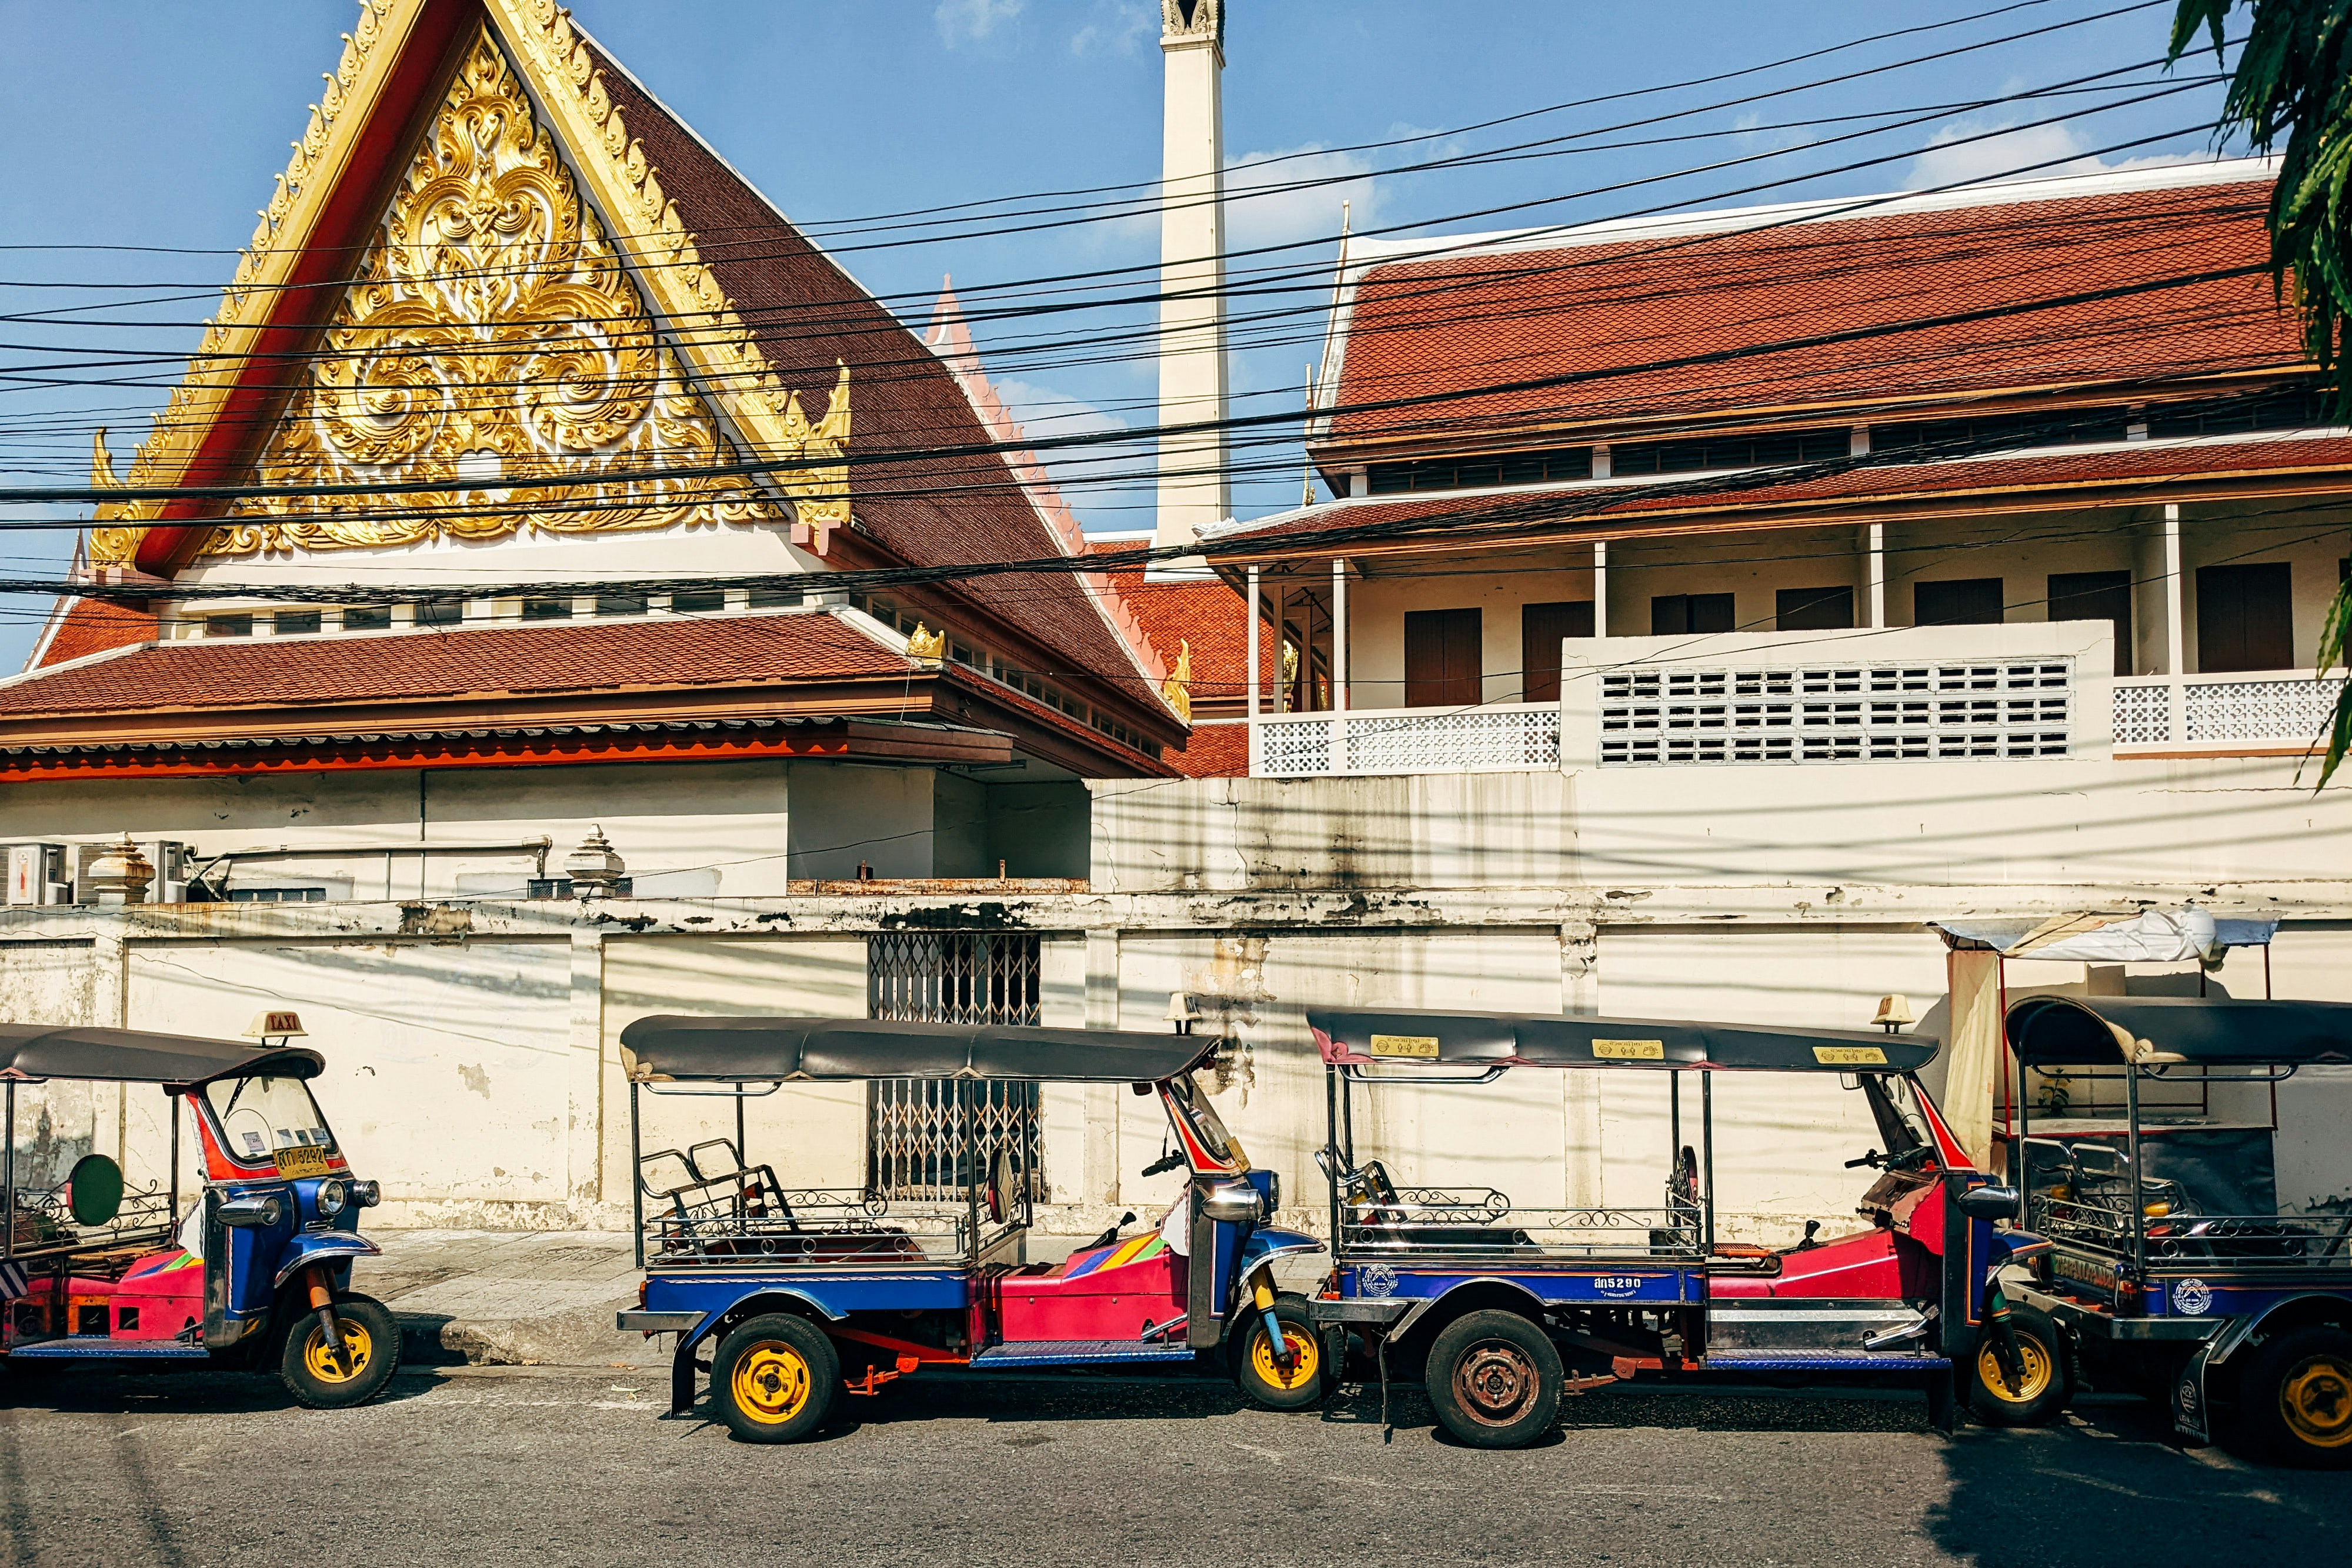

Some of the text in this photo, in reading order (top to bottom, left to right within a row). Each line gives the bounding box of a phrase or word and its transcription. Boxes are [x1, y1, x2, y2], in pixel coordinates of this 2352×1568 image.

[269, 1014, 298, 1032] TAXI
[296, 1147, 324, 1165] 5292
[2054, 1254, 2116, 1290] THAILAND
